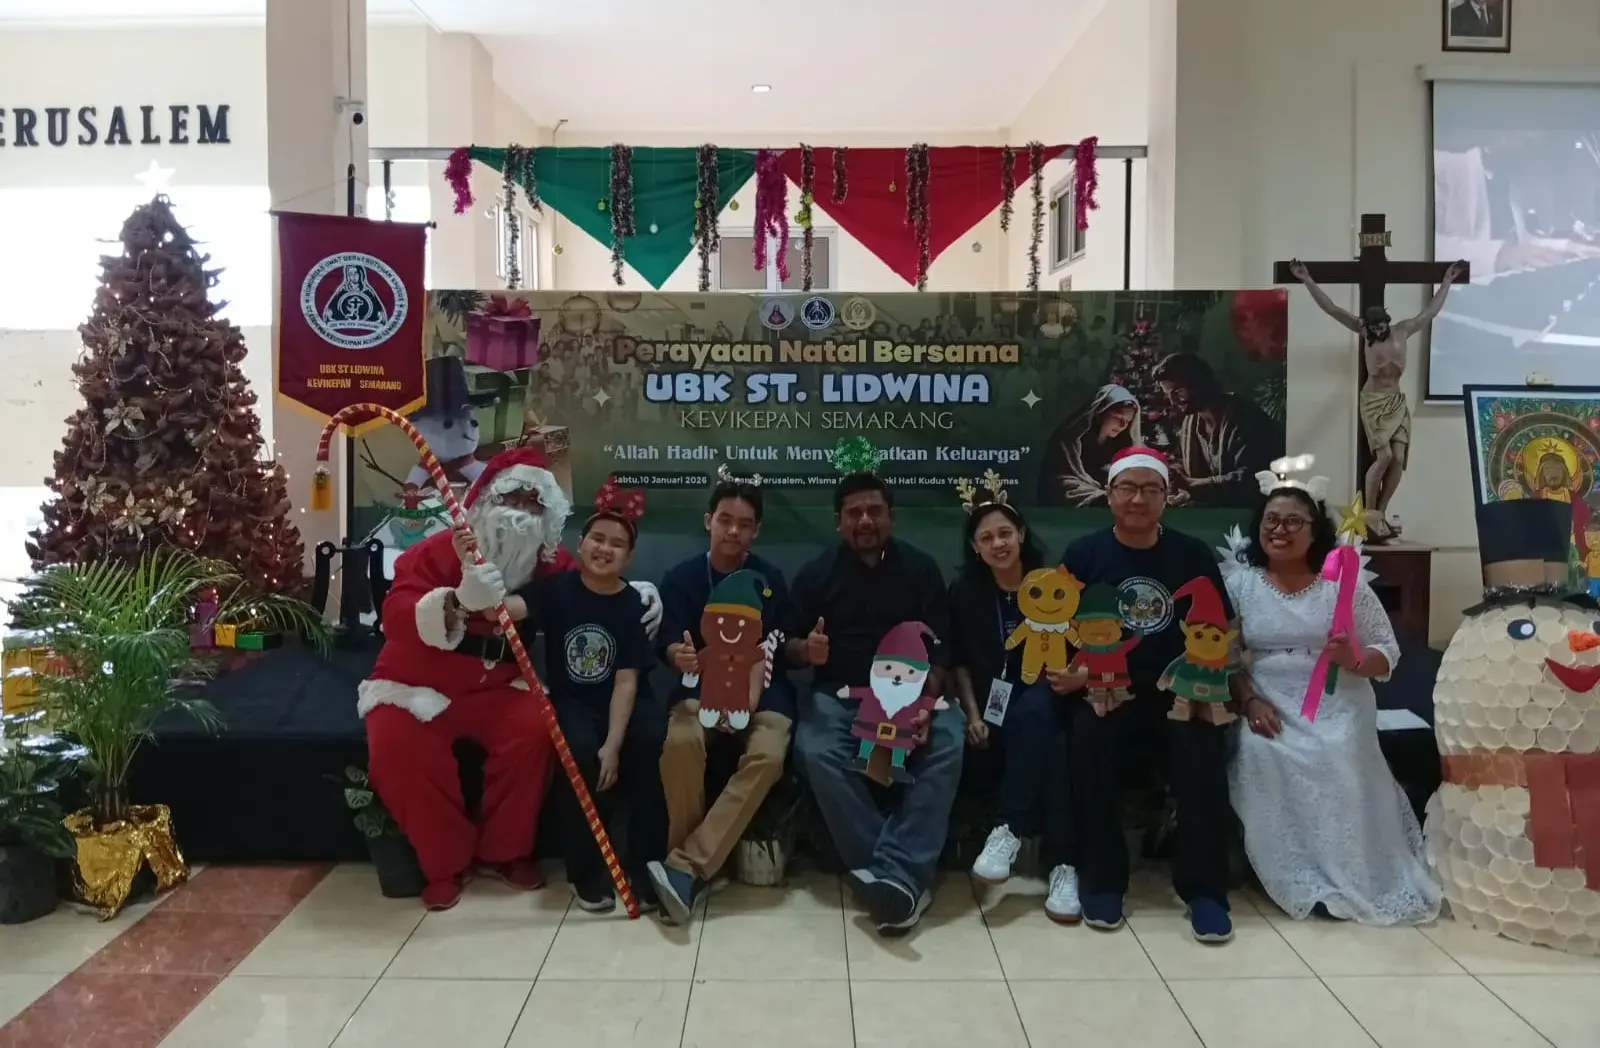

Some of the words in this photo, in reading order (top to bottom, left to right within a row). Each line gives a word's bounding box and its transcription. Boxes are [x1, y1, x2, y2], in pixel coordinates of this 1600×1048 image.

[0, 104, 231, 147] RUSALEM
[613, 338, 773, 370] Perayaan
[779, 339, 867, 363] Natal
[874, 340, 1019, 363] Bersama
[319, 364, 337, 374] UBK
[337, 364, 350, 374] ST
[350, 364, 385, 376] LIDWINA
[306, 378, 352, 389] KEVIKEPAN
[359, 379, 402, 391] SEMARANG
[646, 372, 733, 402] UBK
[746, 373, 808, 403] ST.
[822, 372, 989, 404] LIDWINA
[681, 410, 811, 429] KEVIKEPAN
[821, 411, 955, 429] SEMARANG
[666, 444, 718, 460] Hadir
[726, 444, 778, 460] Untuk
[651, 476, 683, 485] Januari
[685, 476, 708, 485] 2026
[808, 476, 837, 485] Wisma
[898, 476, 917, 485] Hati
[918, 476, 946, 485] Kudus
